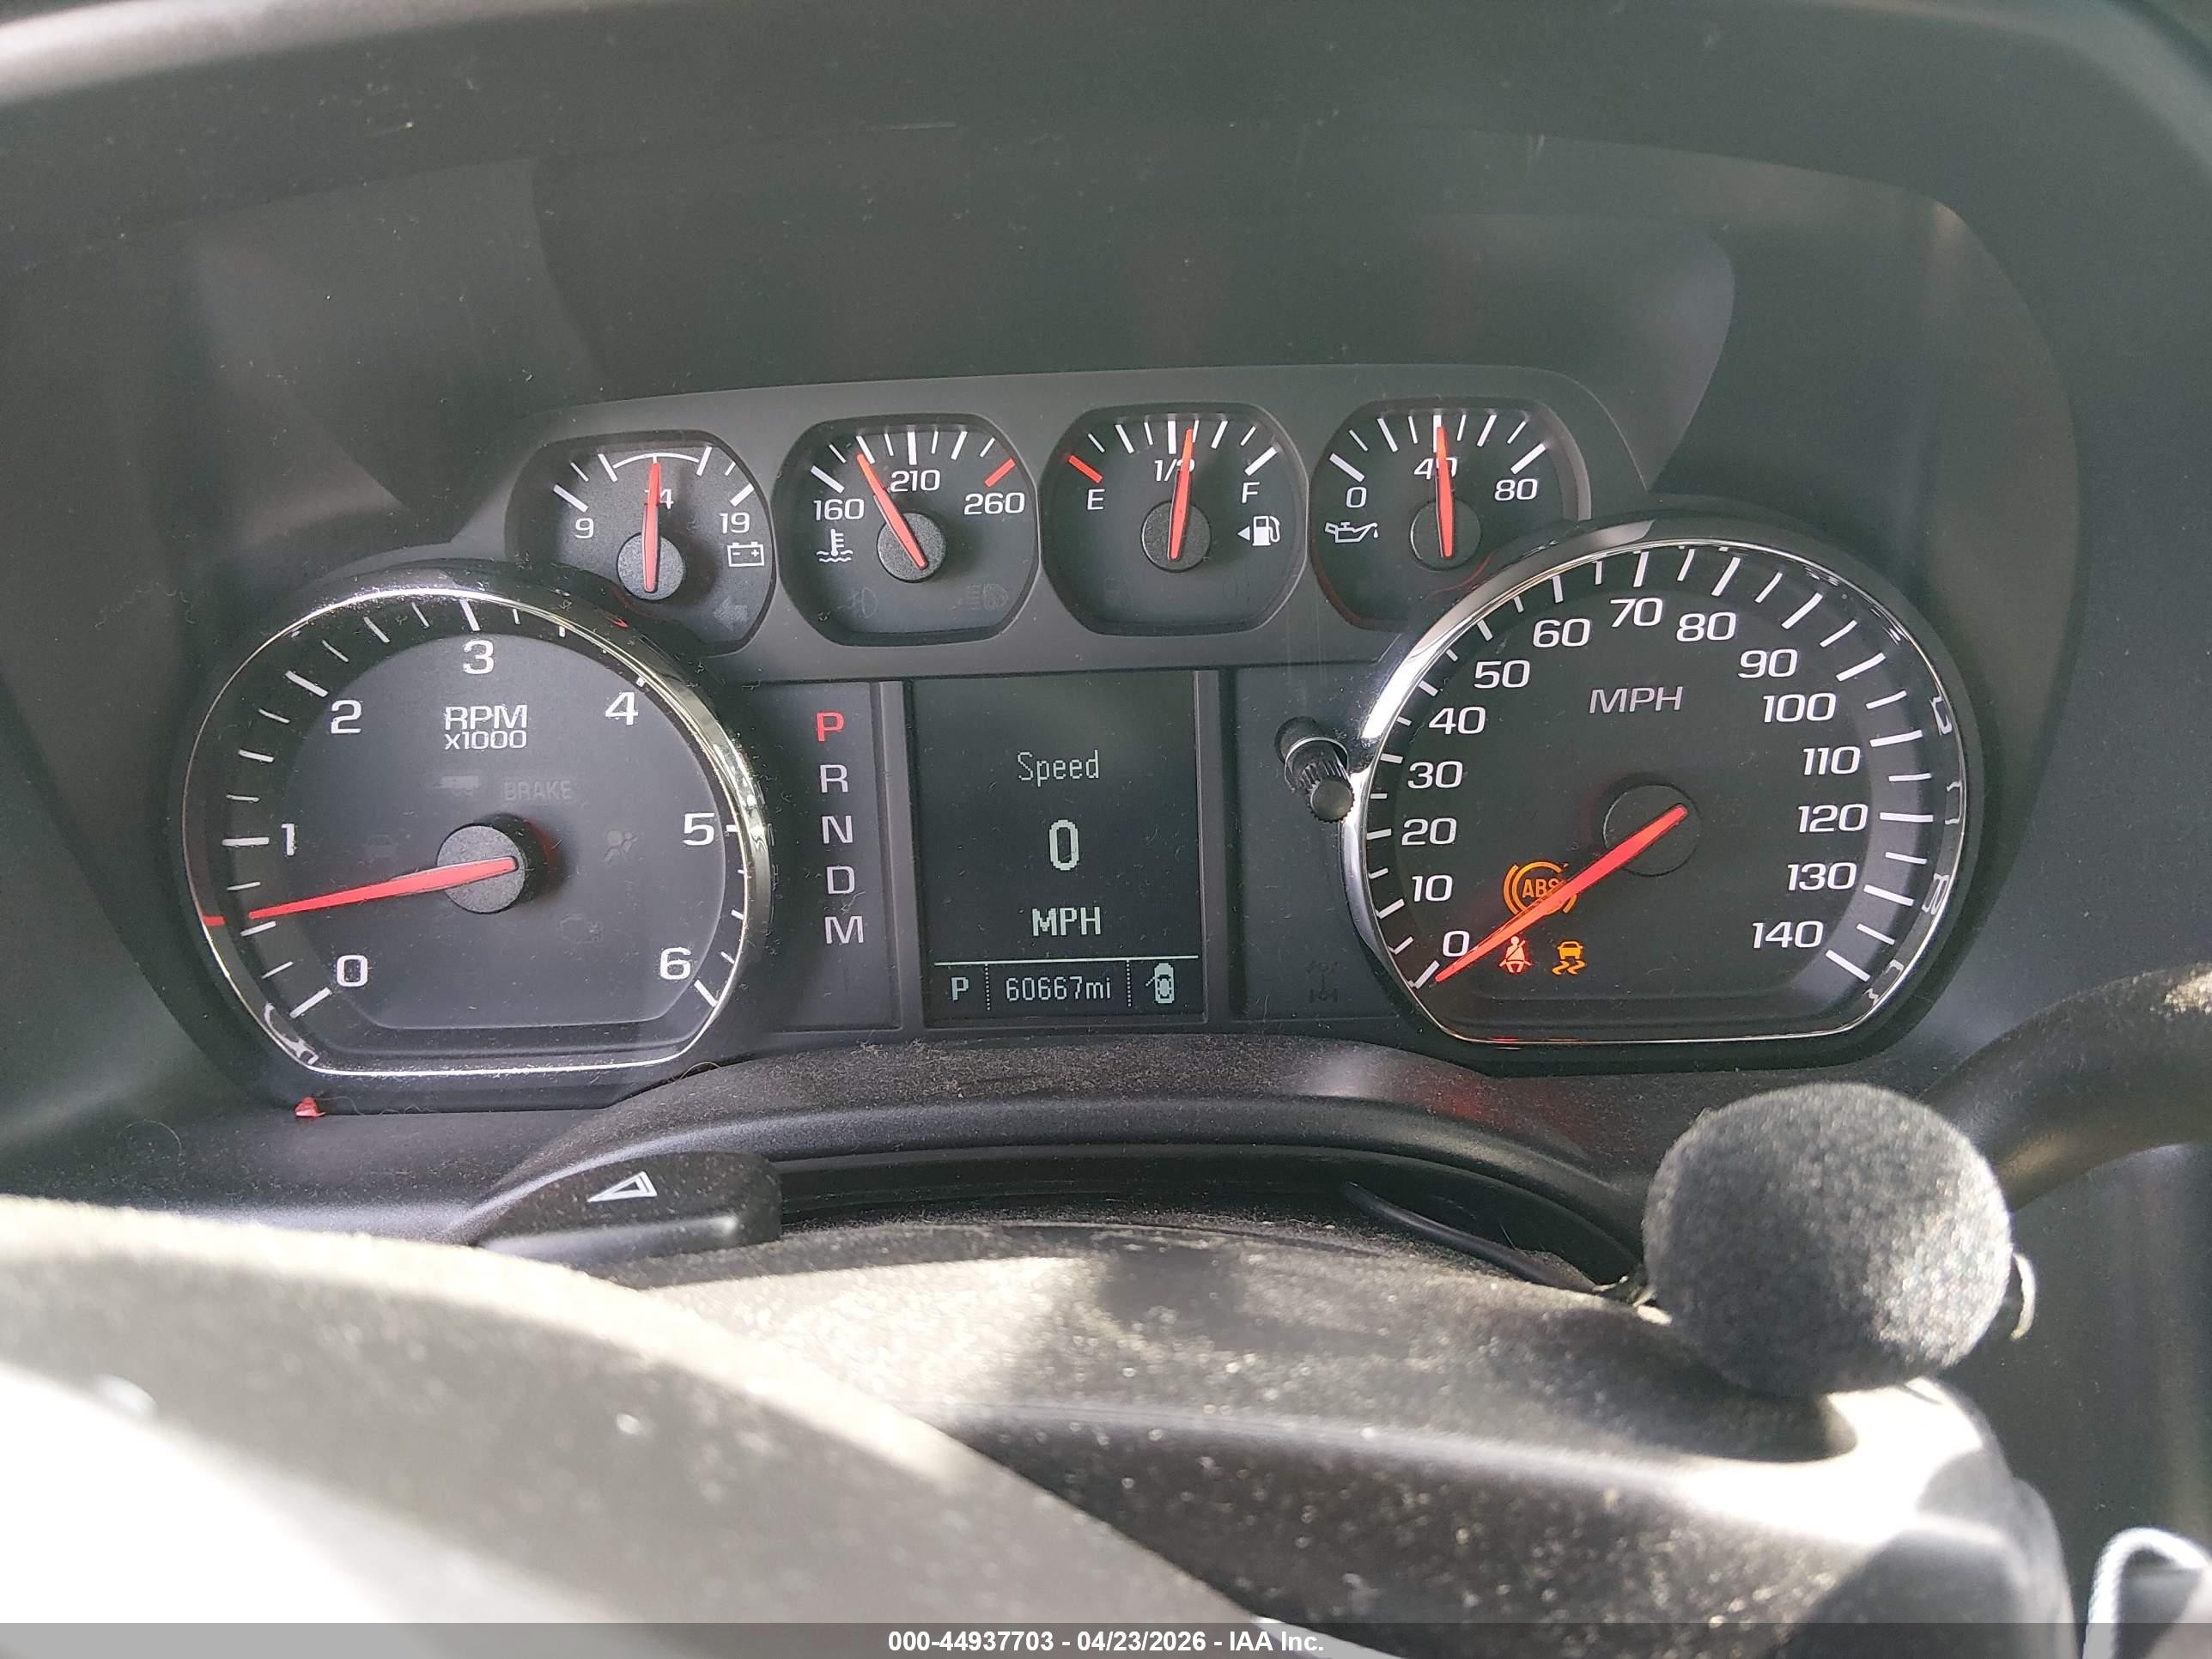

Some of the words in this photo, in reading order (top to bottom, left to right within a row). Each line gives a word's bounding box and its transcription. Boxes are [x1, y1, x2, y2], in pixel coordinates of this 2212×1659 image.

[890, 469, 940, 492] 210
[1242, 482, 1261, 503] F
[1494, 478, 1538, 501] 80
[644, 489, 674, 509] 4
[813, 498, 865, 521] 160
[963, 492, 1025, 515] 260
[1087, 489, 1105, 510] E
[1346, 487, 1367, 508] 0
[574, 518, 594, 539] 9
[720, 512, 750, 534] 19
[1610, 597, 1663, 627] 70
[1676, 611, 1737, 642] 80
[1533, 618, 1591, 648] 60
[462, 640, 495, 675] 3
[1737, 648, 1798, 678] 90
[1474, 659, 1530, 689] 50
[605, 691, 639, 726] 4
[1589, 686, 1683, 714] MPH
[1763, 692, 1837, 723] 100
[331, 699, 362, 734] 2
[444, 704, 528, 730] RPM
[816, 712, 844, 742] P
[1428, 706, 1486, 735] 40
[444, 730, 527, 750] x1000
[1017, 749, 1099, 787] Speed
[1407, 761, 1463, 789] 30
[1803, 746, 1862, 775] 110
[503, 780, 572, 802] BRAKE
[819, 764, 848, 793] R
[683, 812, 715, 846] 5
[822, 815, 854, 844] N
[1401, 817, 1457, 846] 20
[1798, 803, 1869, 833] 120
[280, 823, 295, 856] 1
[1048, 819, 1079, 871] 0
[826, 866, 855, 895] D
[1412, 874, 1453, 902] 10
[1787, 862, 1857, 891] 130
[824, 915, 864, 945] M
[1031, 906, 1101, 937] MPH
[1752, 921, 1824, 949] 140
[1443, 930, 1469, 957] 0
[336, 954, 368, 988] 0
[659, 946, 691, 981] 6
[951, 976, 969, 1001] P
[1006, 975, 1111, 1001] 60667mi
